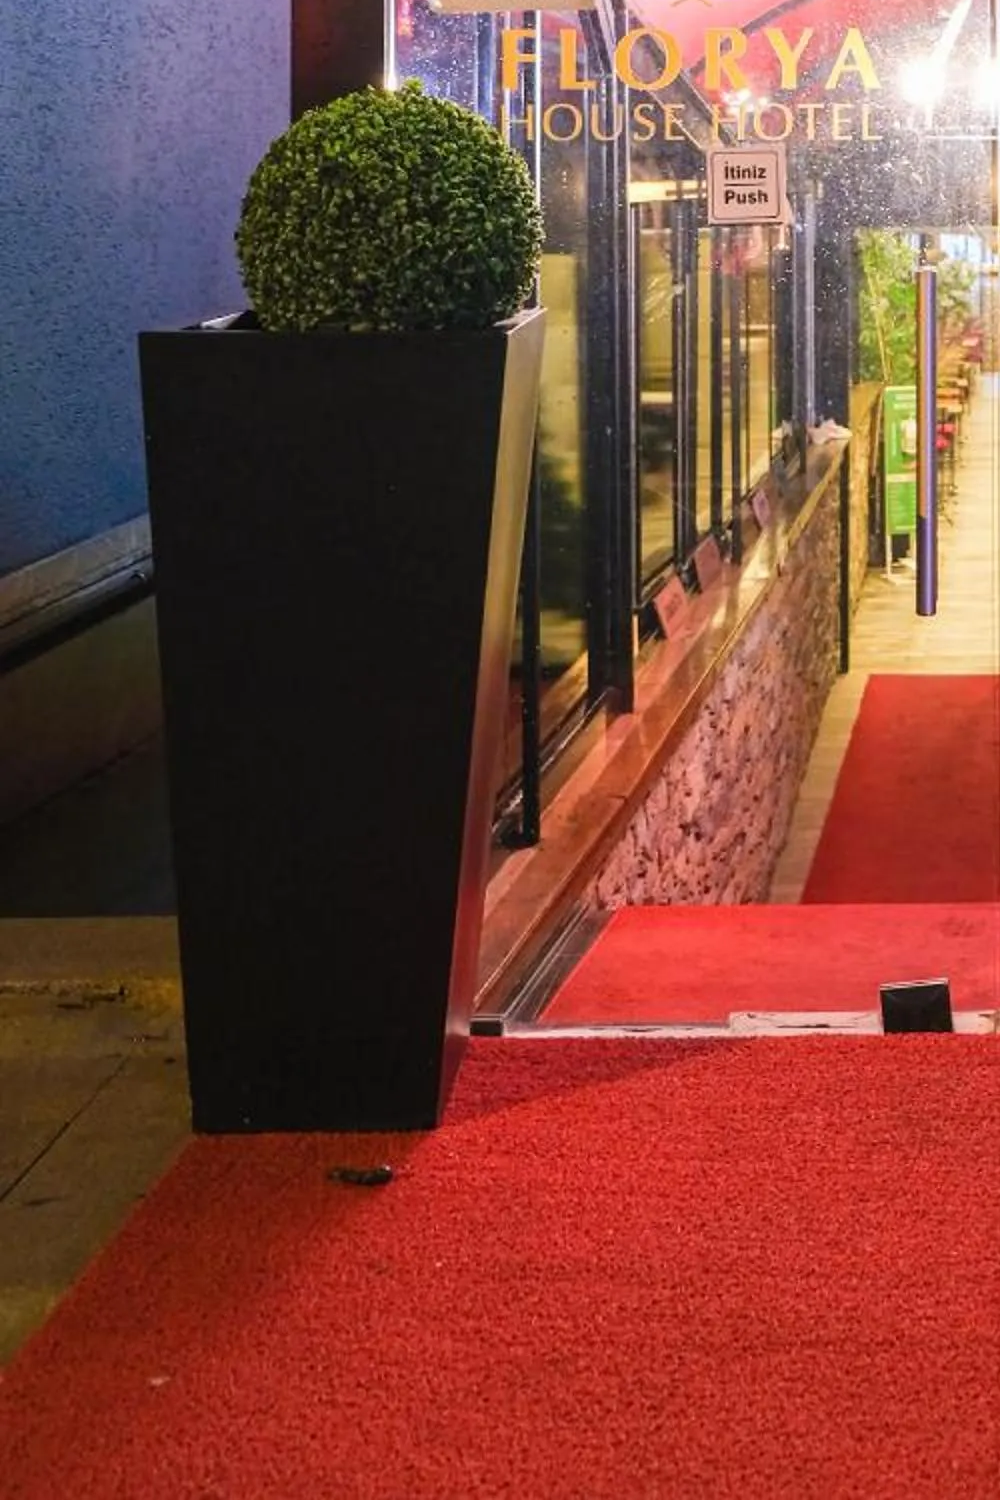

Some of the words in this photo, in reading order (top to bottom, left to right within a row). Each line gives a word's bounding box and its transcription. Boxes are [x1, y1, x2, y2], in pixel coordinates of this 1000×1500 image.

[501, 27, 882, 92] FLORYA
[501, 103, 685, 141] HOUSE
[712, 103, 884, 141] HOTEL
[724, 189, 769, 205] Push
